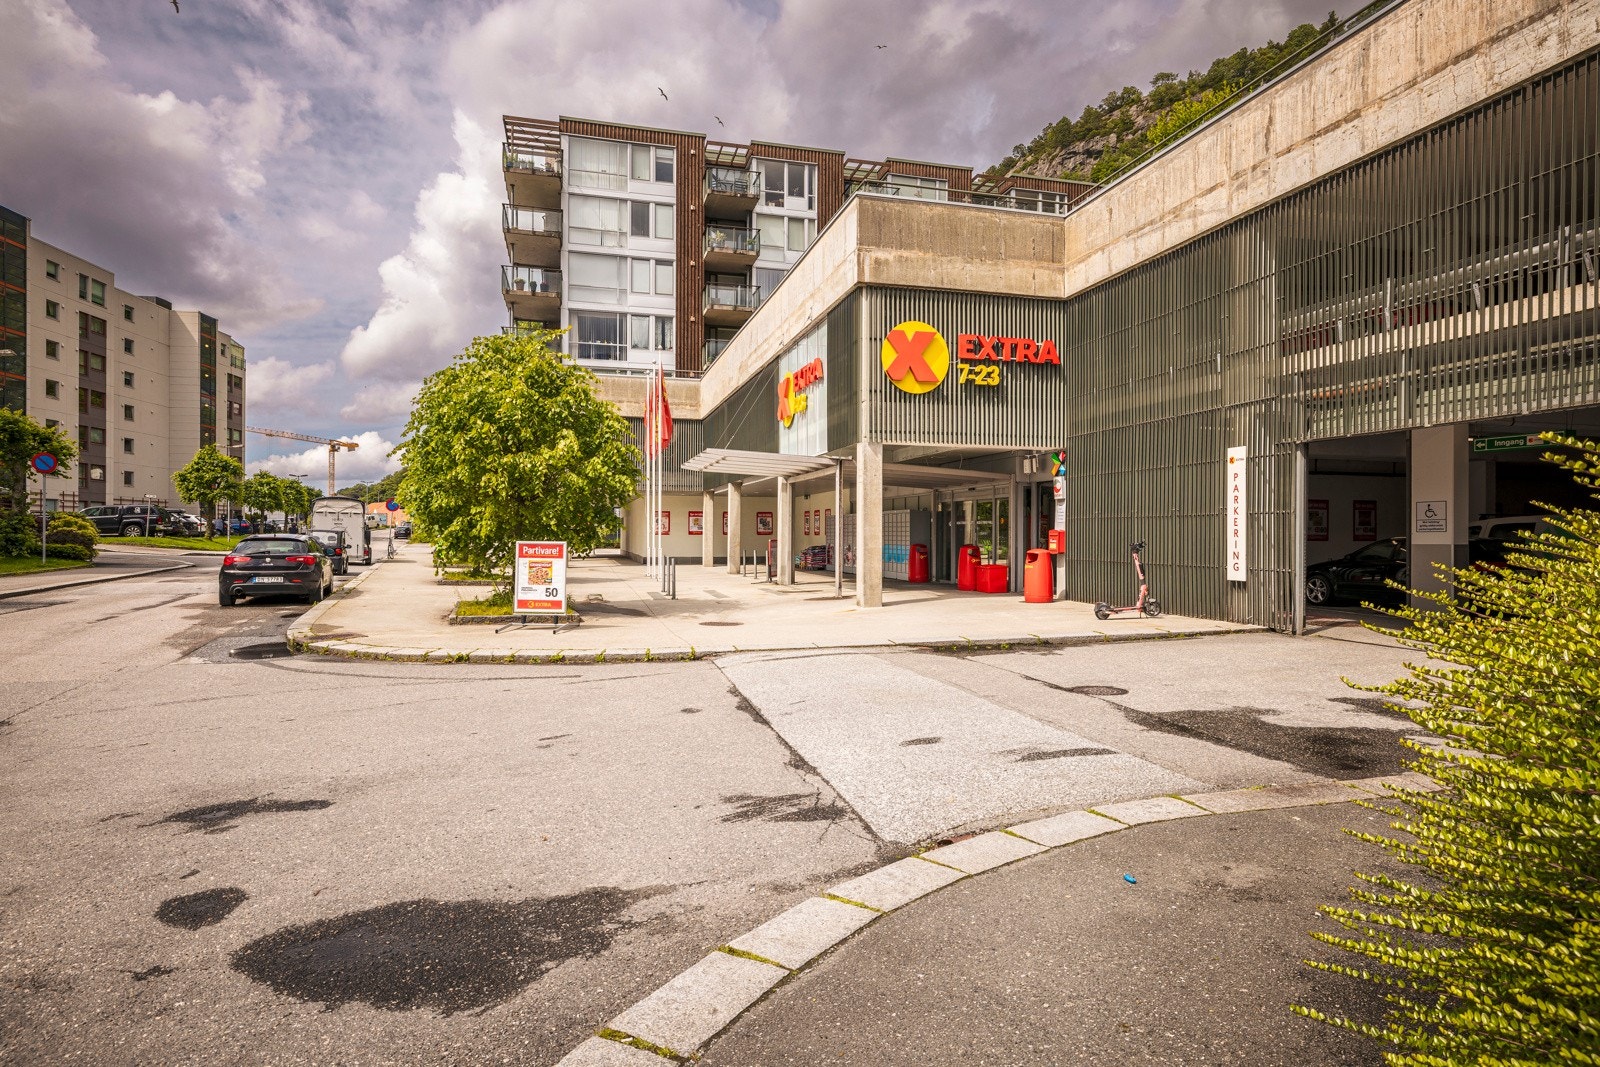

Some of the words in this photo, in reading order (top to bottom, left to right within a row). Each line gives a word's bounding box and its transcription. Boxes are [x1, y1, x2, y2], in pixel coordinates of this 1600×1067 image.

[886, 329, 940, 383] X
[958, 333, 1061, 365] EXTRA
[793, 357, 824, 393] EXTRA
[957, 363, 1000, 386] 7-23
[1494, 439, 1524, 447] Inngang
[1232, 472, 1240, 572] PARKERING
[522, 546, 559, 555] Partivare!
[545, 587, 558, 598] 50
